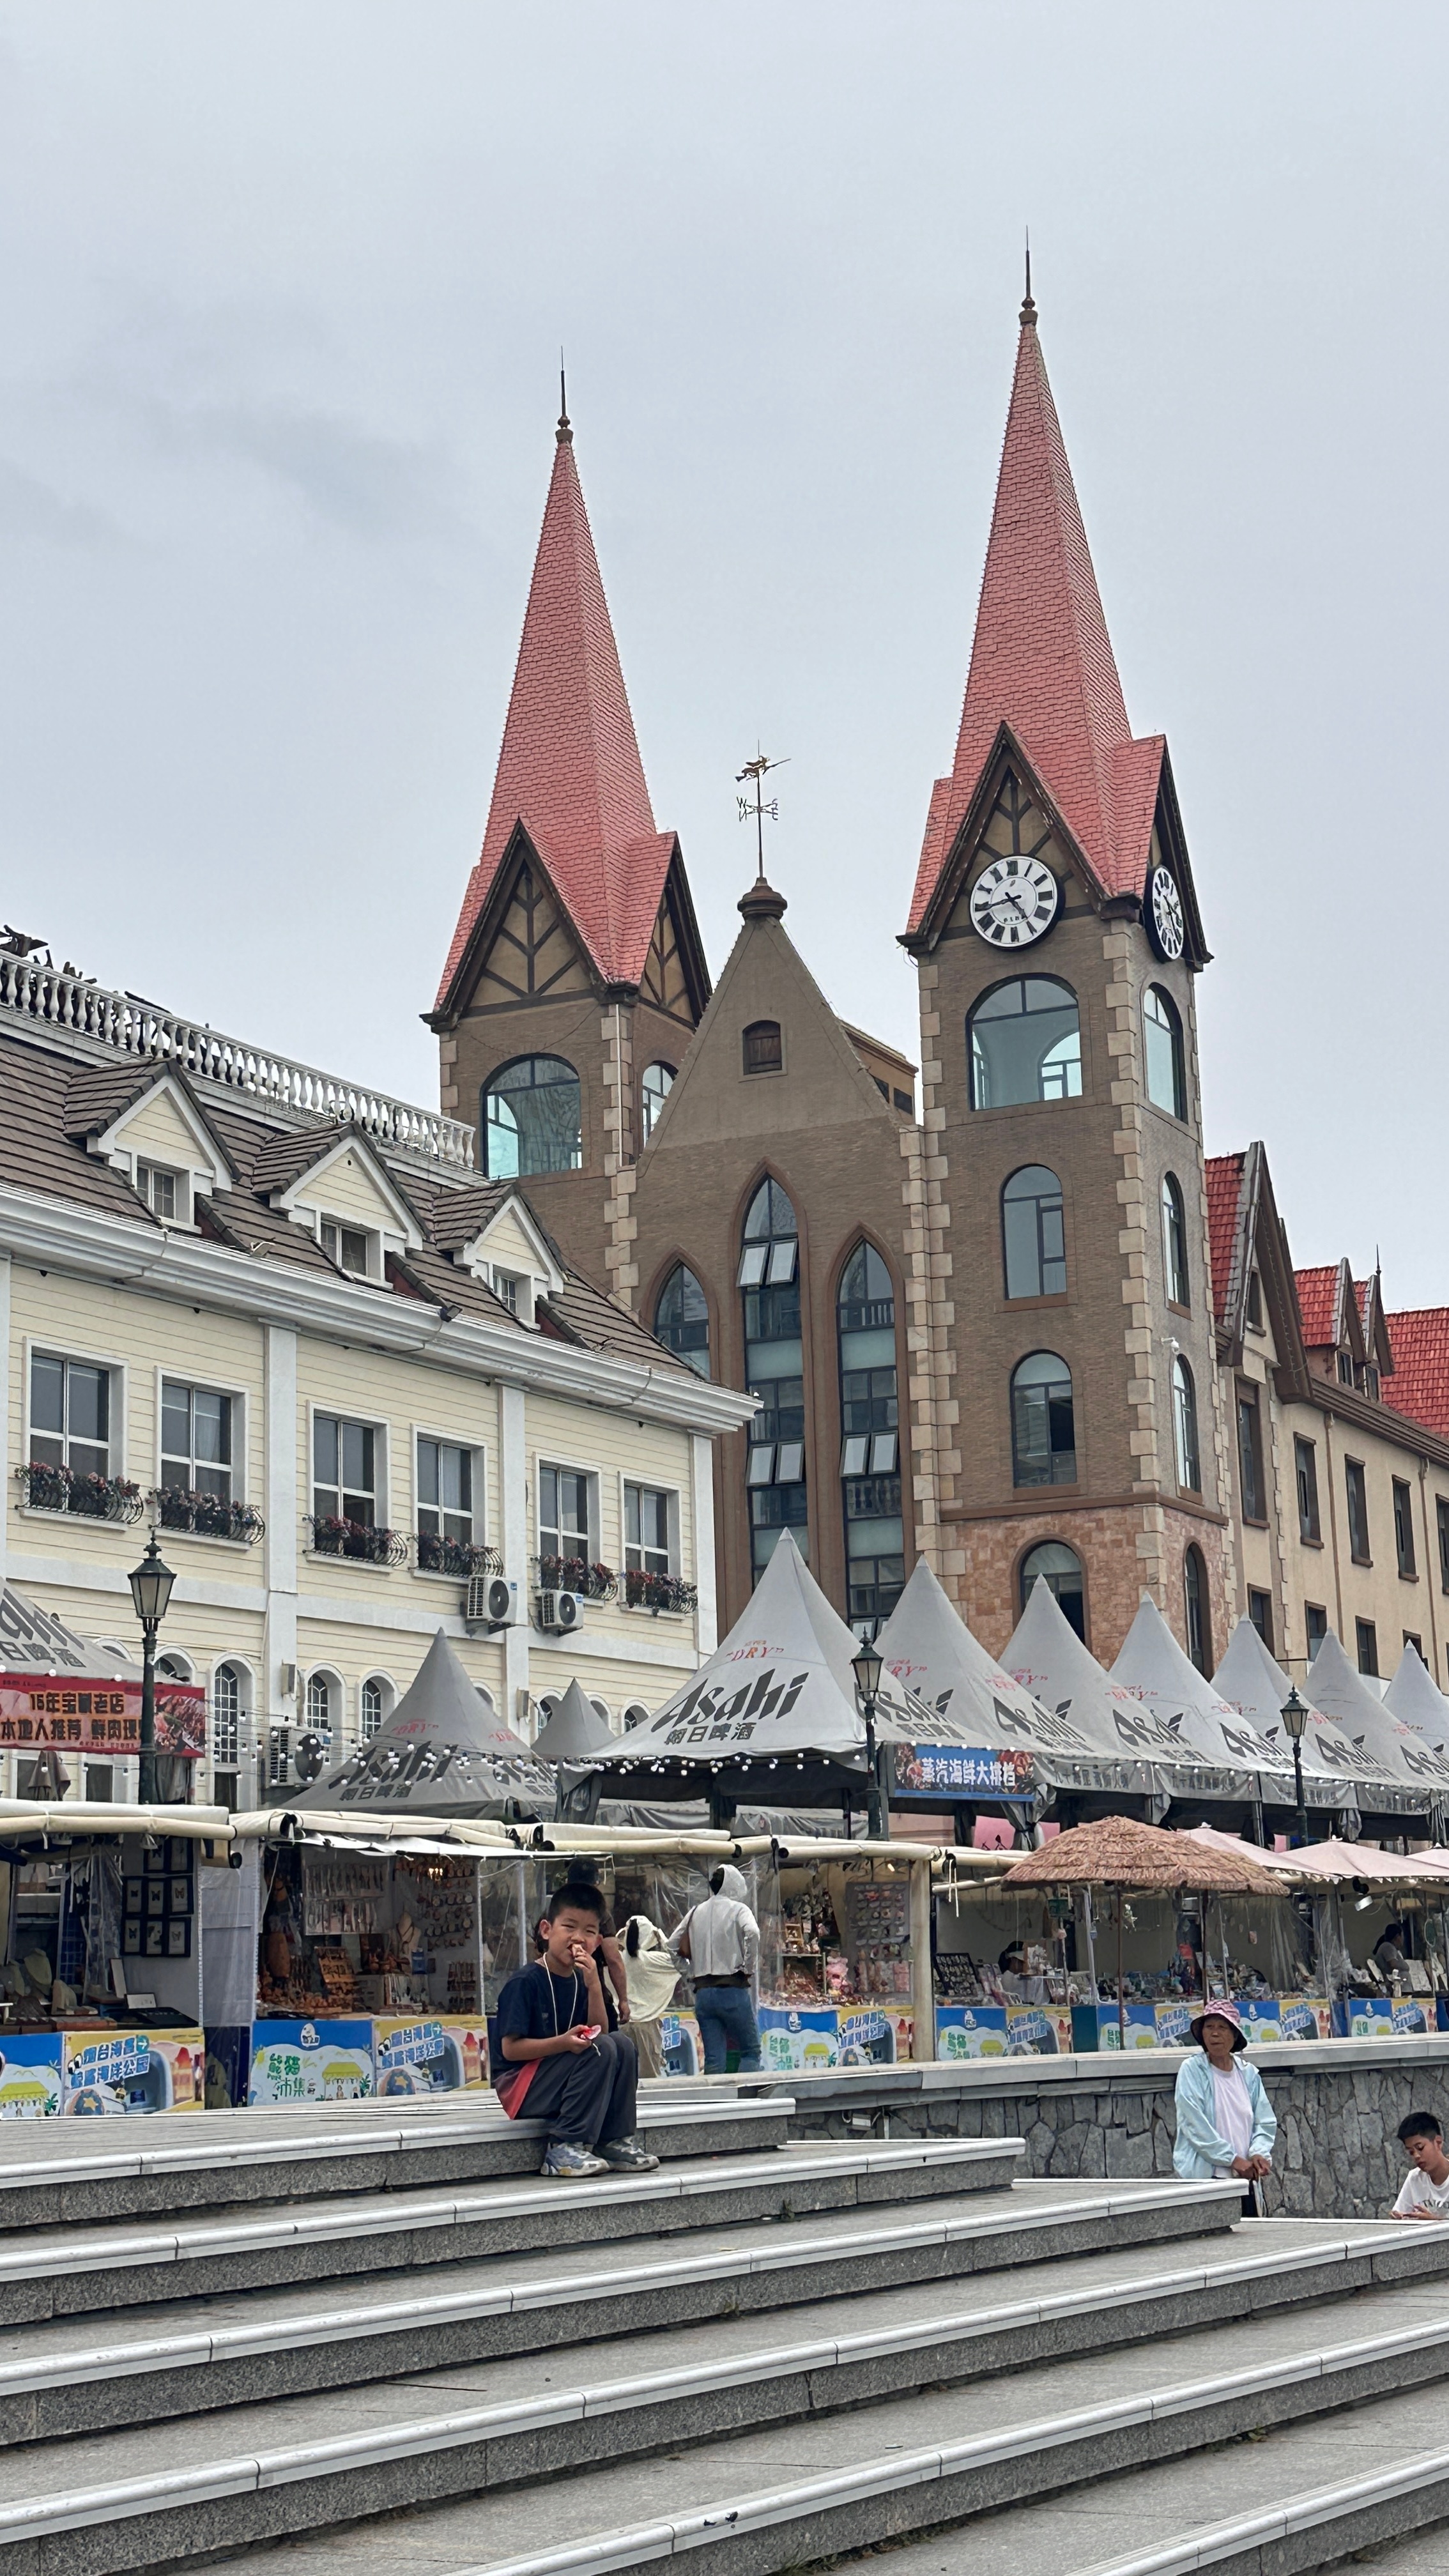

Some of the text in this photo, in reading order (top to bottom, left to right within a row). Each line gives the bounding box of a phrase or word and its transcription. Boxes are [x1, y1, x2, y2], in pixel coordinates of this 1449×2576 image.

[0, 1640, 87, 1668] 日啤酒
[650, 1668, 809, 1733] Asahi
[664, 1722, 756, 1745] 朝日啤酒
